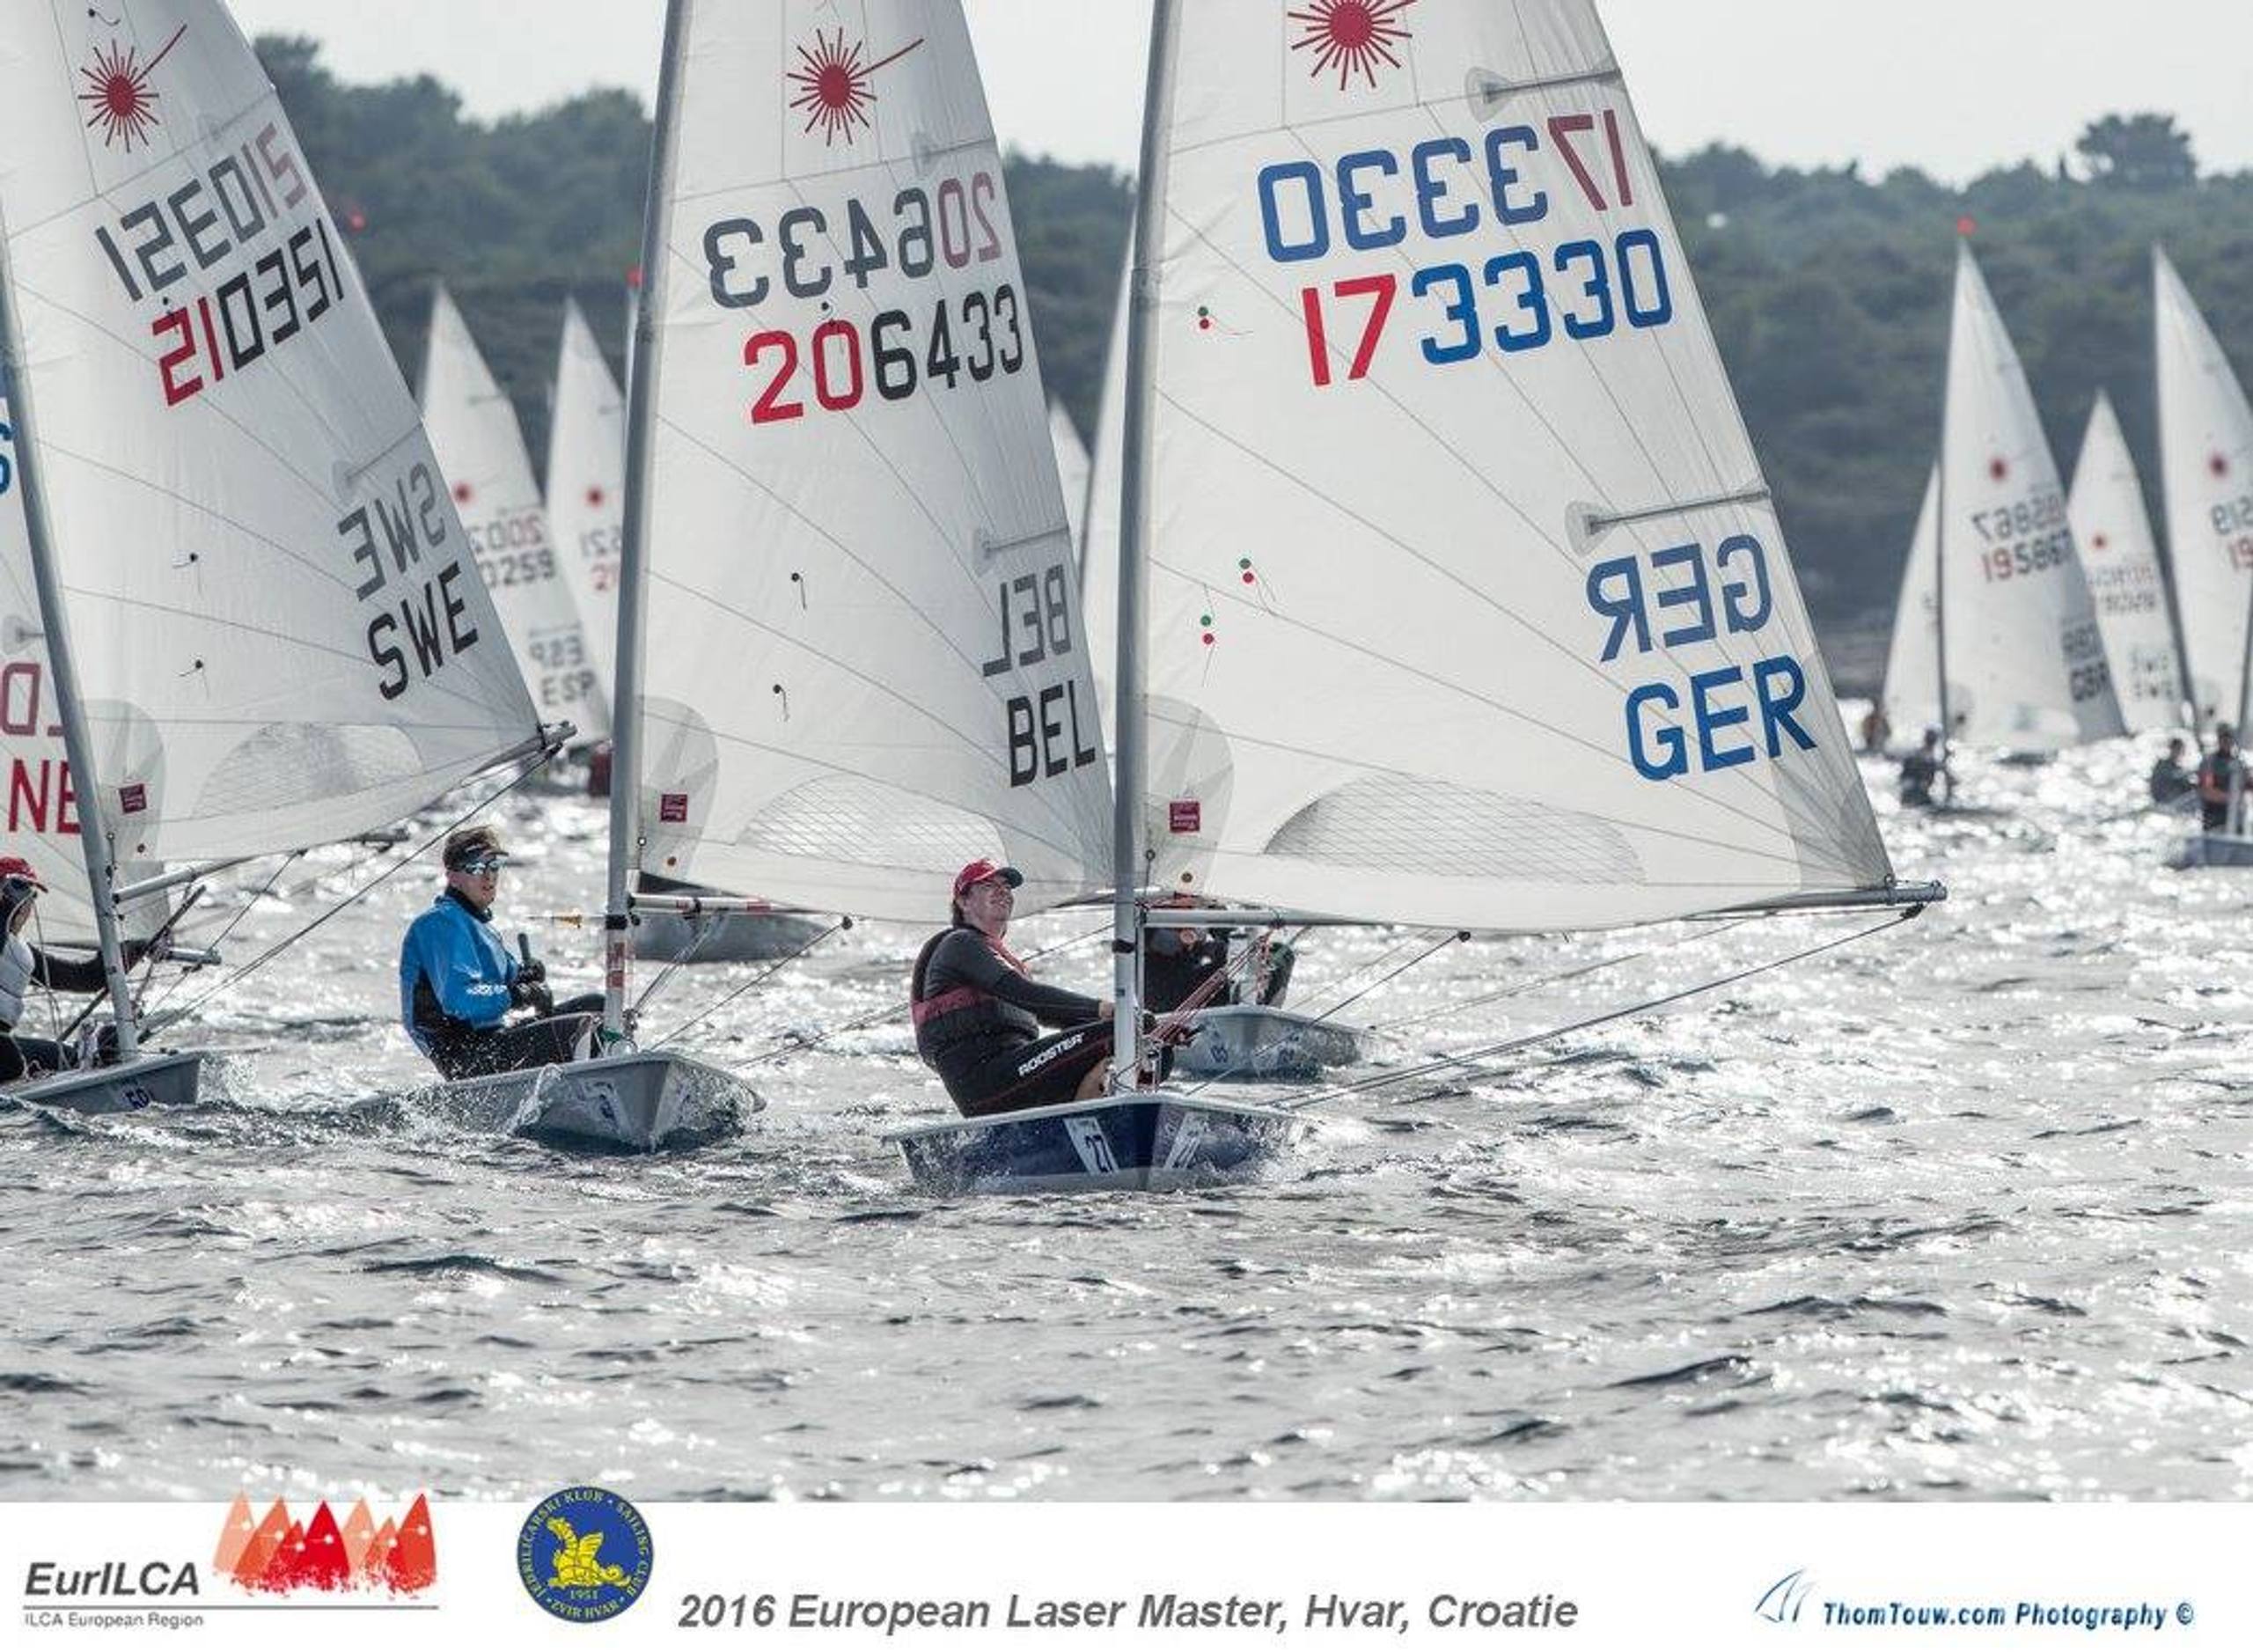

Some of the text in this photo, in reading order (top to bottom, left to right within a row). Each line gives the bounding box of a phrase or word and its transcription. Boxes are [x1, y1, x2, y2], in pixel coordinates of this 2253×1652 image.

[151, 218, 345, 407] 210351
[744, 283, 1024, 424] 206433
[1302, 229, 1673, 386] 173330
[367, 562, 479, 701] SWE
[1007, 680, 1096, 787] BEL
[1626, 655, 1817, 782] GER
[1018, 1032, 1085, 1076] ROOSTER
[1084, 1134, 1112, 1172] 27
